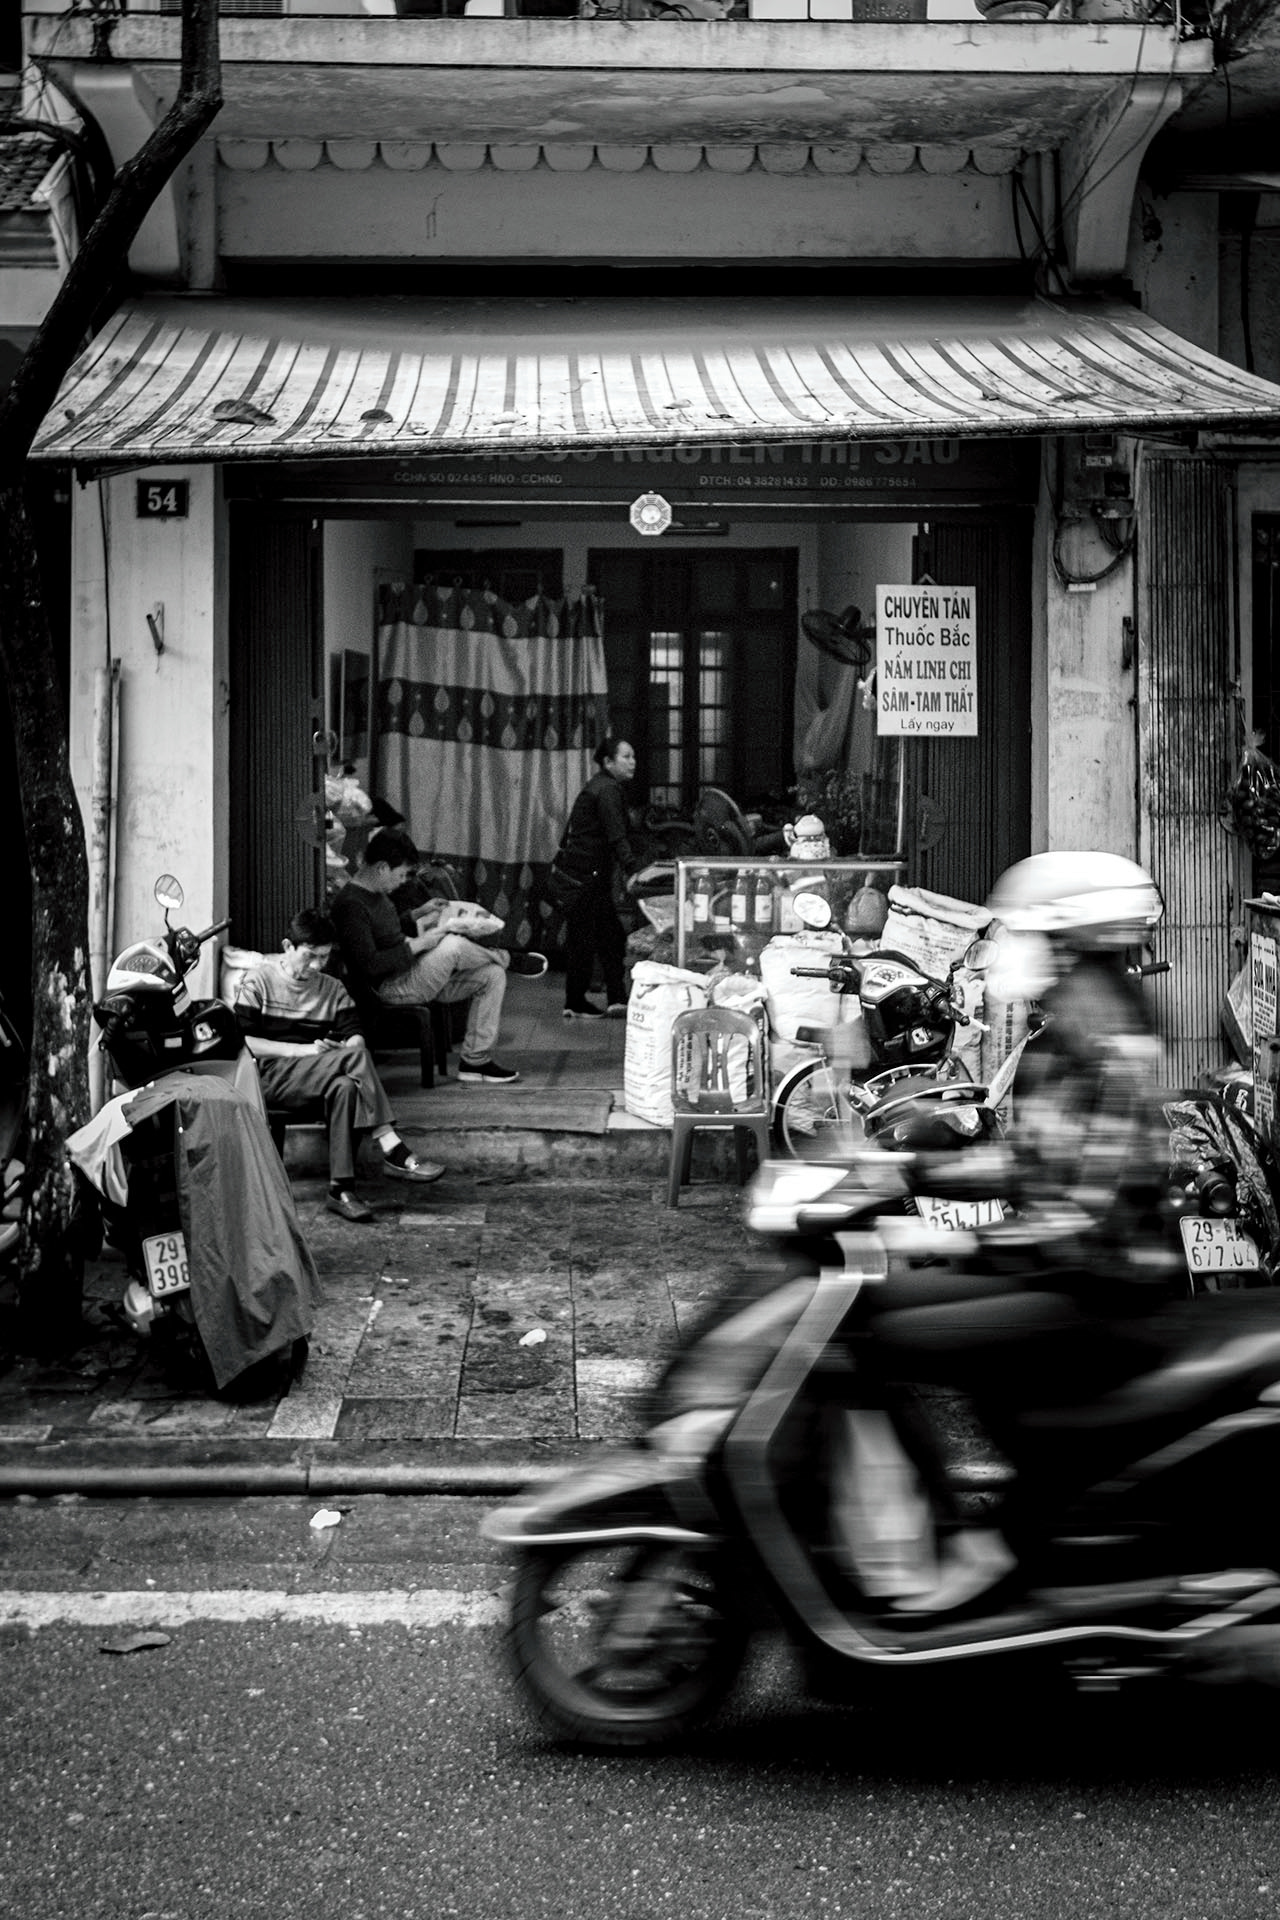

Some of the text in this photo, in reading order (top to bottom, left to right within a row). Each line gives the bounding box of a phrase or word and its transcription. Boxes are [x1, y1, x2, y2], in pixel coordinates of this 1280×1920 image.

[147, 486, 178, 512] 54
[884, 590, 970, 619] CHUYÊN TÁN
[884, 624, 970, 646] Thuốc Bắc
[884, 651, 971, 680] NẤM LINH CHI
[945, 684, 973, 713] THẤT
[900, 717, 954, 732] Lấy ngay
[154, 1261, 191, 1291] 398
